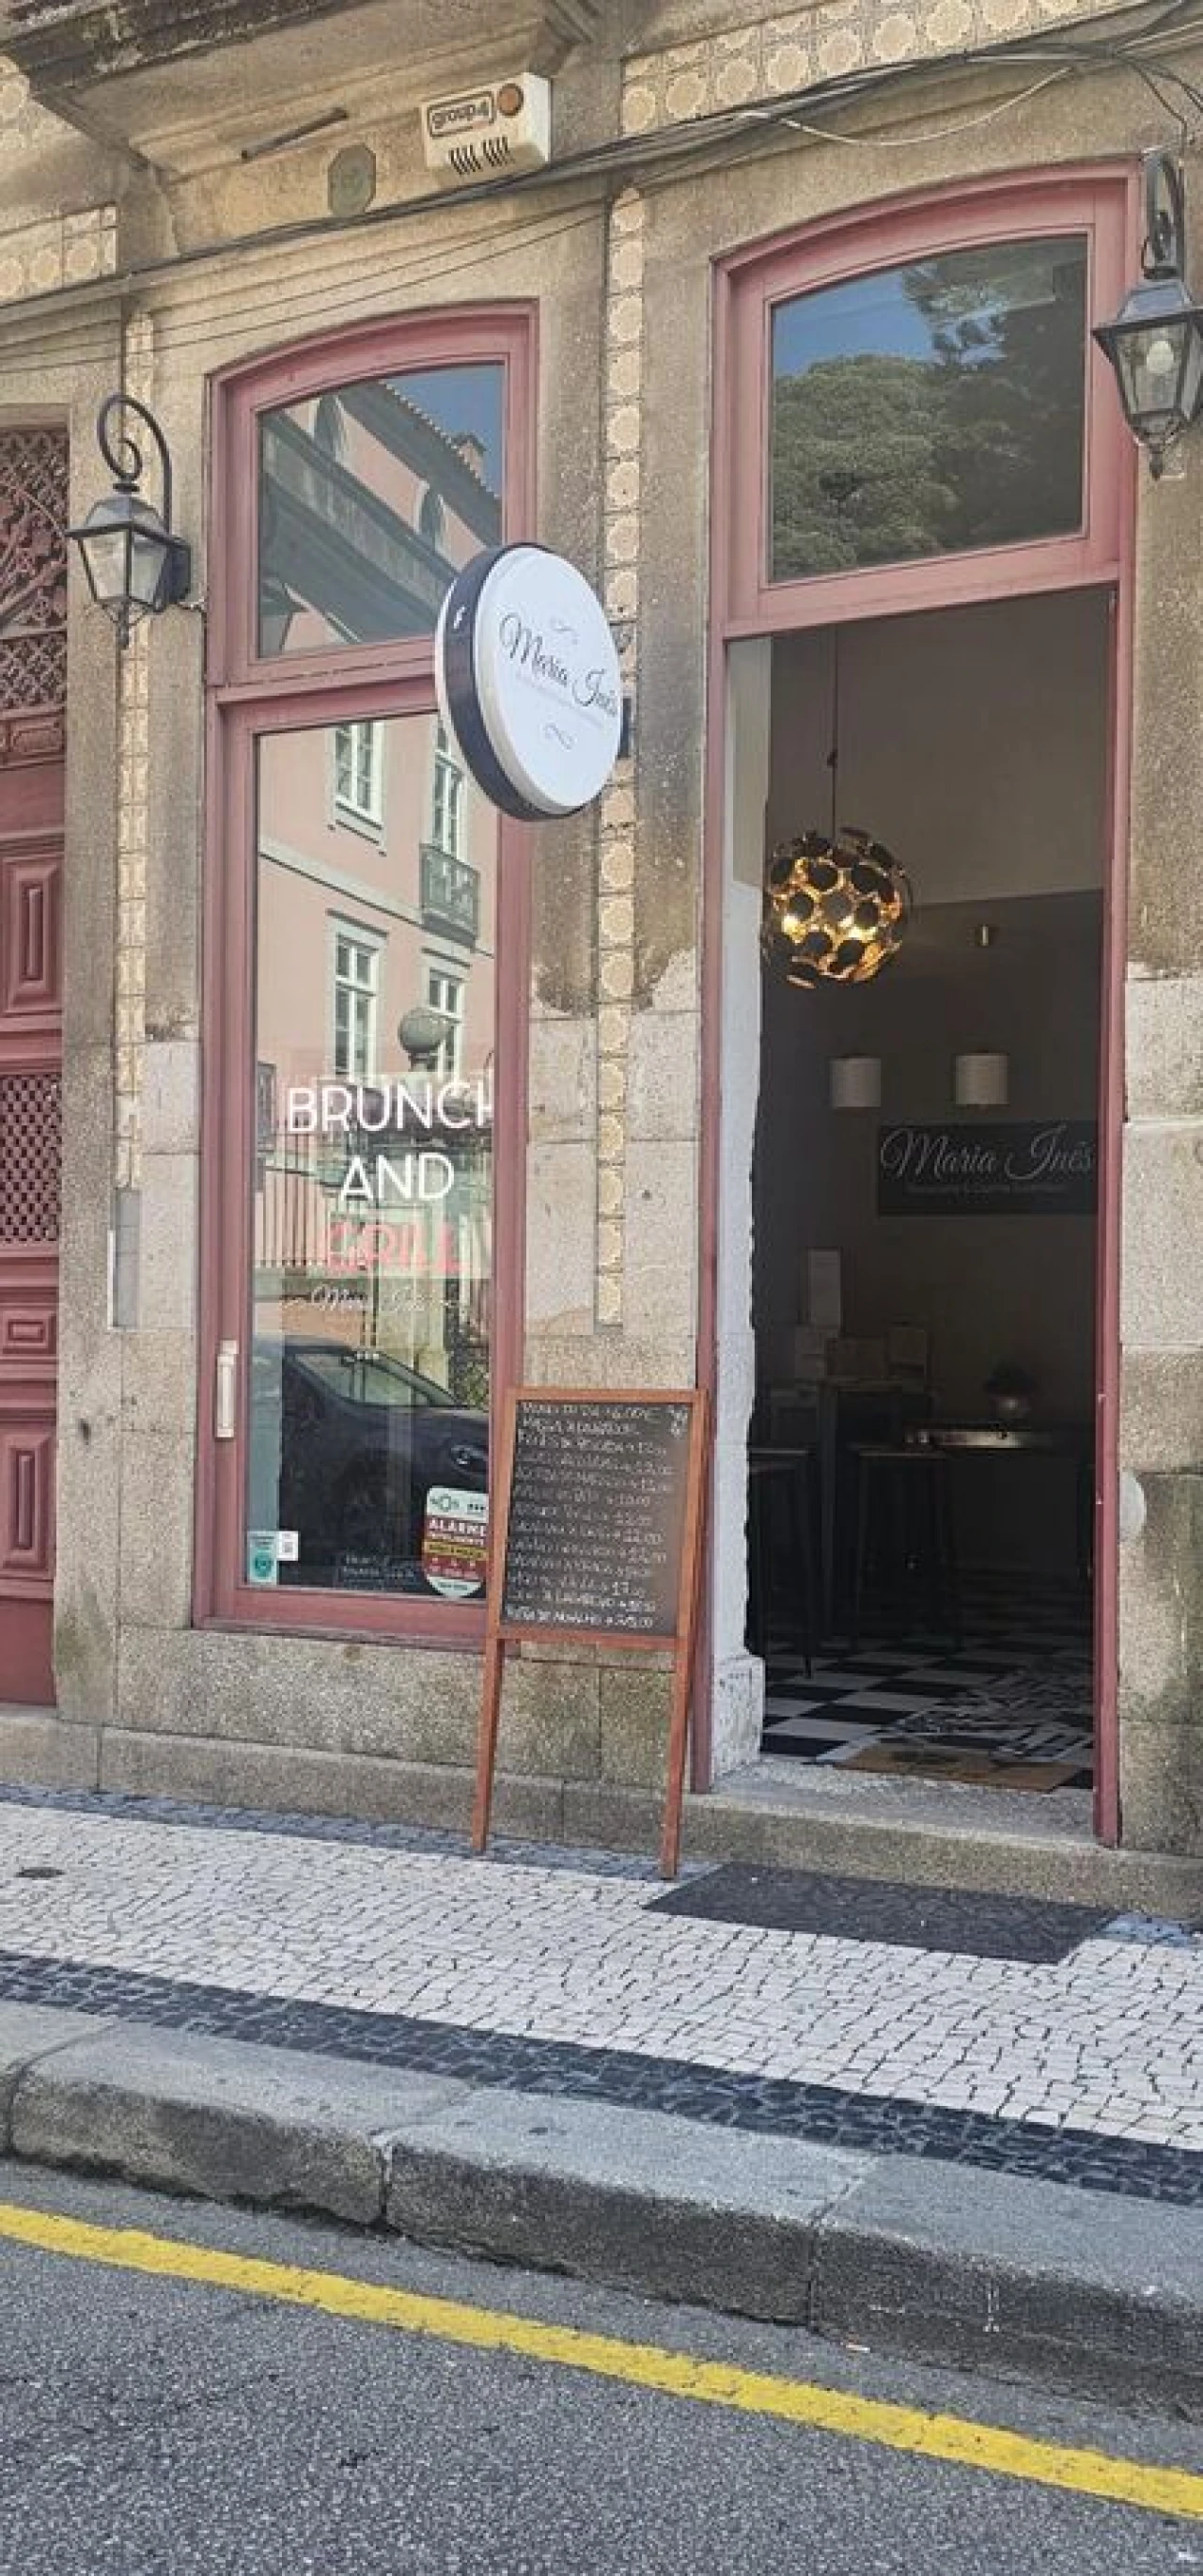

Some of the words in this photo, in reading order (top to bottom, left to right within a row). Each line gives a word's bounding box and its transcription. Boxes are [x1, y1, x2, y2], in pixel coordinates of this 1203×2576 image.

[499, 612, 568, 688] Maria
[340, 1152, 455, 1202] AND
[881, 1126, 996, 1178] Maria
[324, 1221, 467, 1273] GRILL
